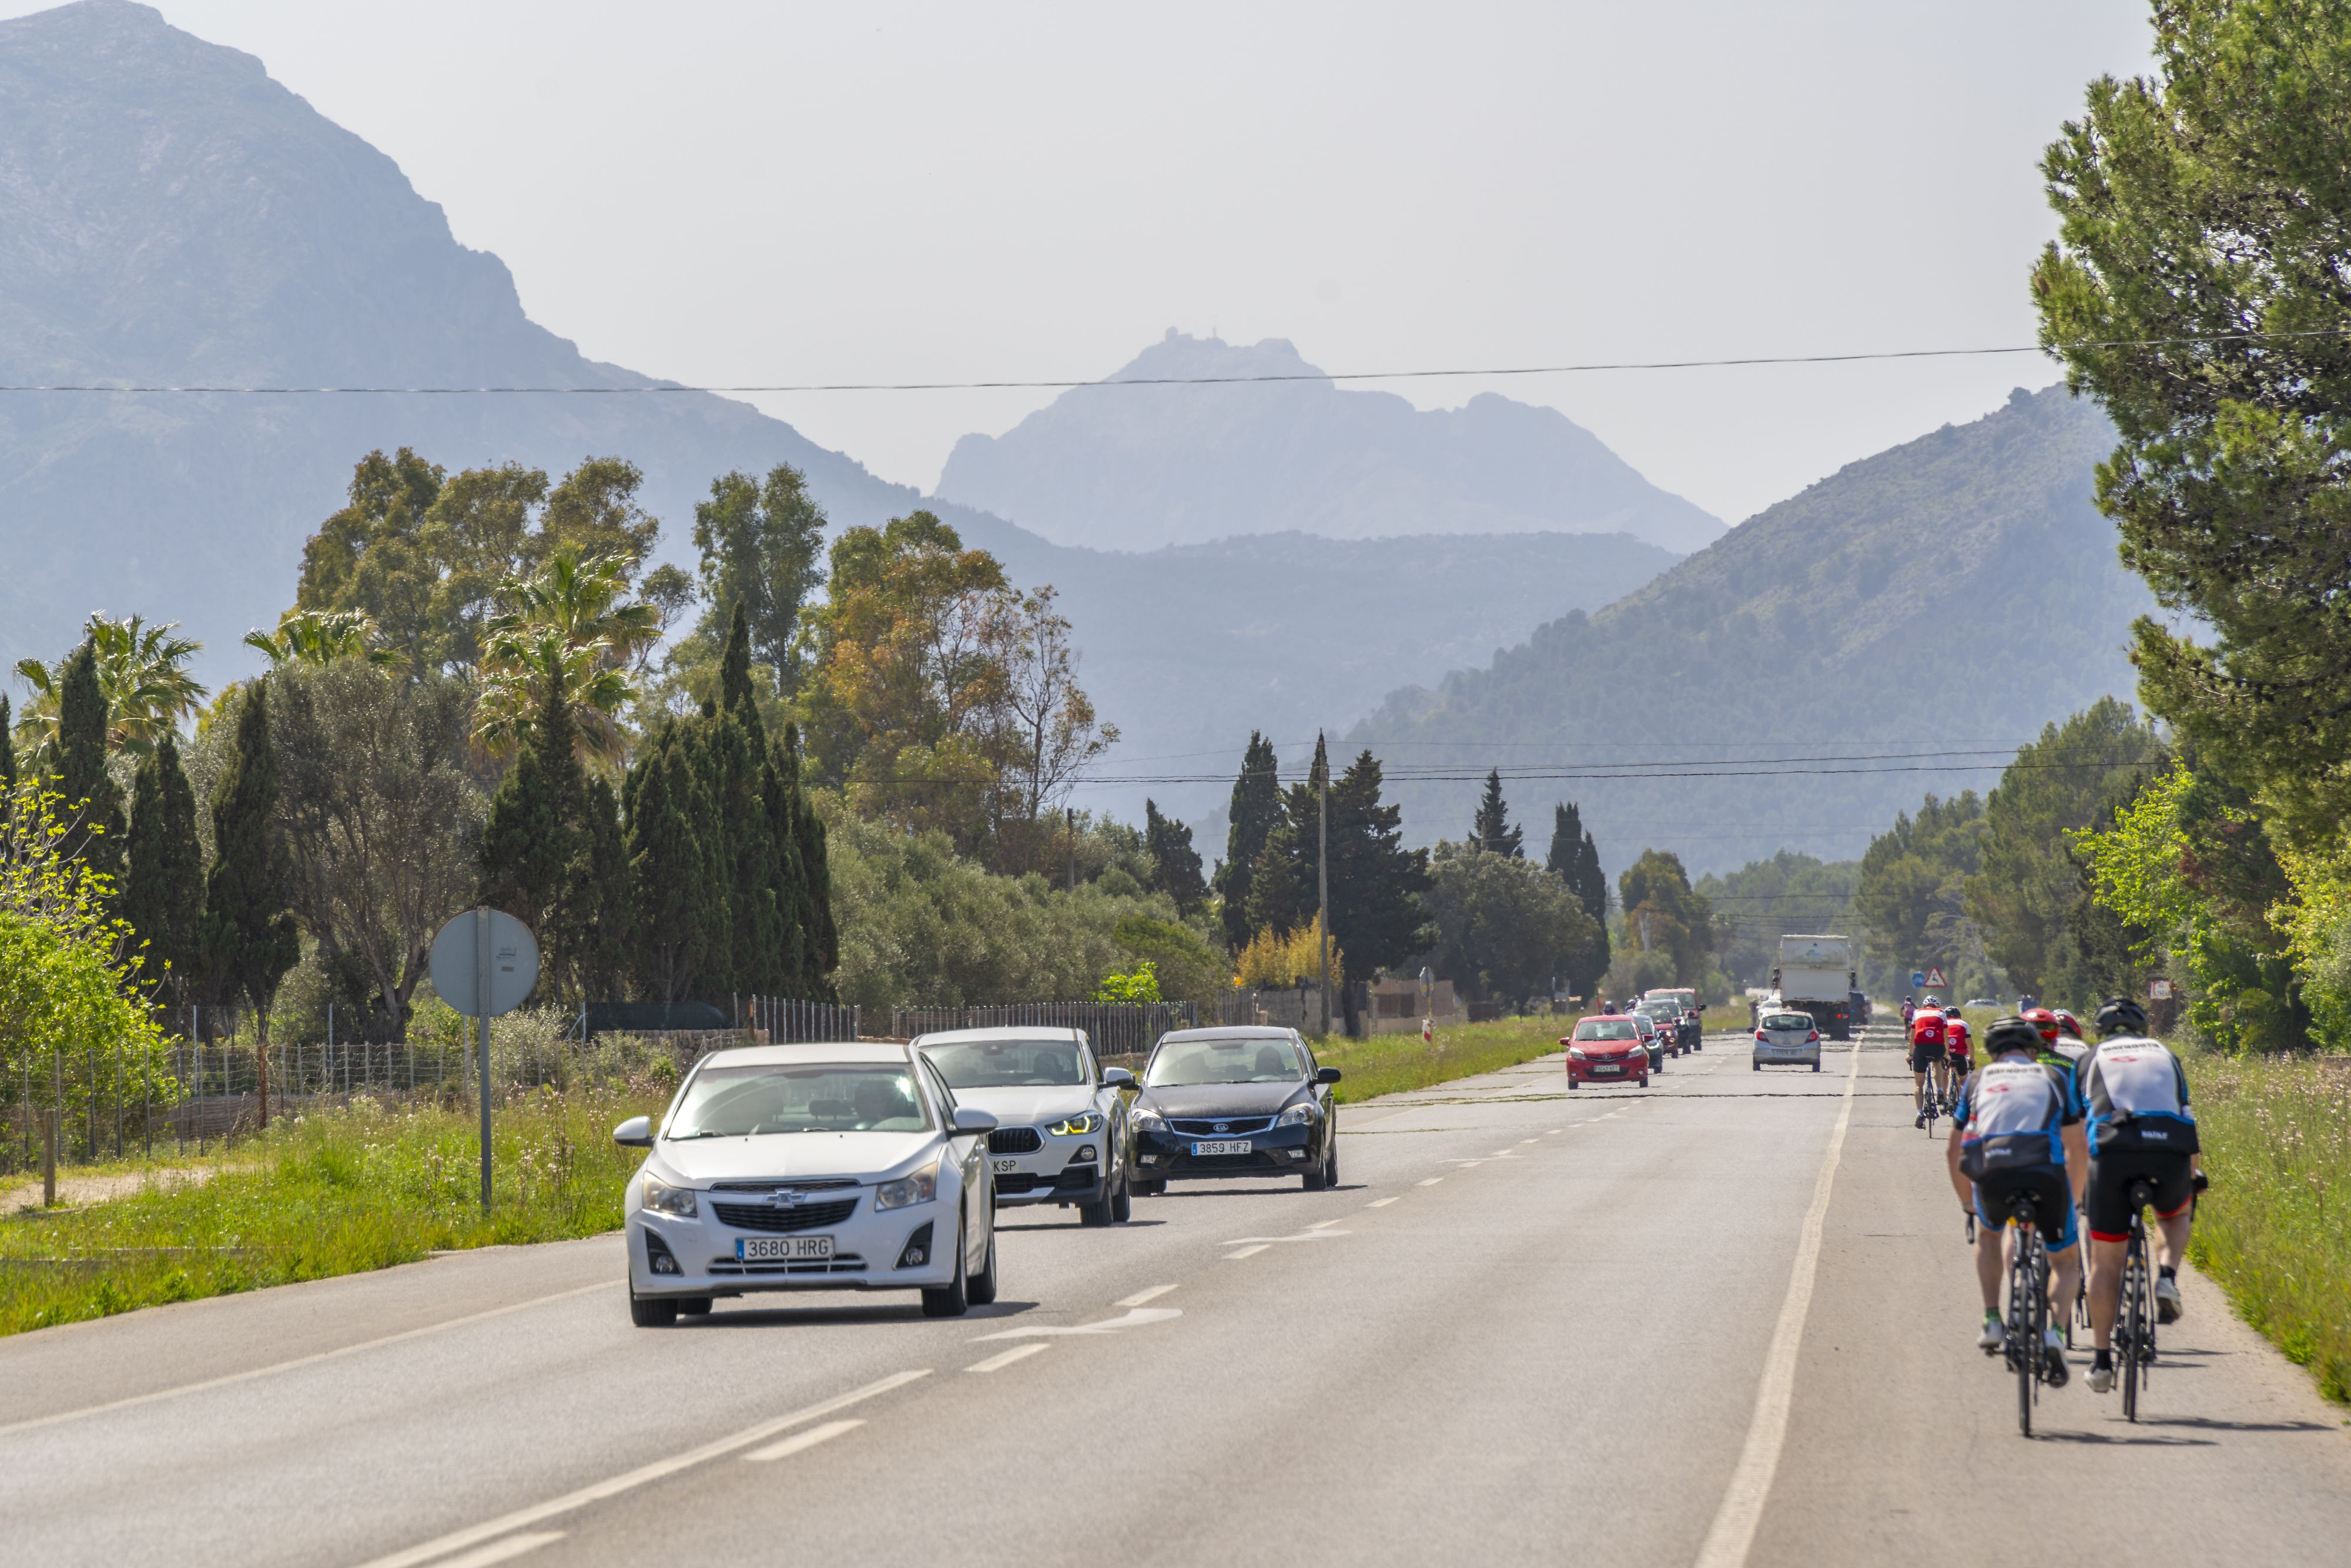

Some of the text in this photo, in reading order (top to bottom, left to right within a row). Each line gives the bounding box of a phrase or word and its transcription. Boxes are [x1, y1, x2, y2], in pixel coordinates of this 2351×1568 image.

[1200, 1142, 1249, 1153] 3859 HFZ
[993, 1160, 1016, 1172] KSP
[748, 1240, 790, 1257] 3680
[796, 1239, 828, 1255] HRG
